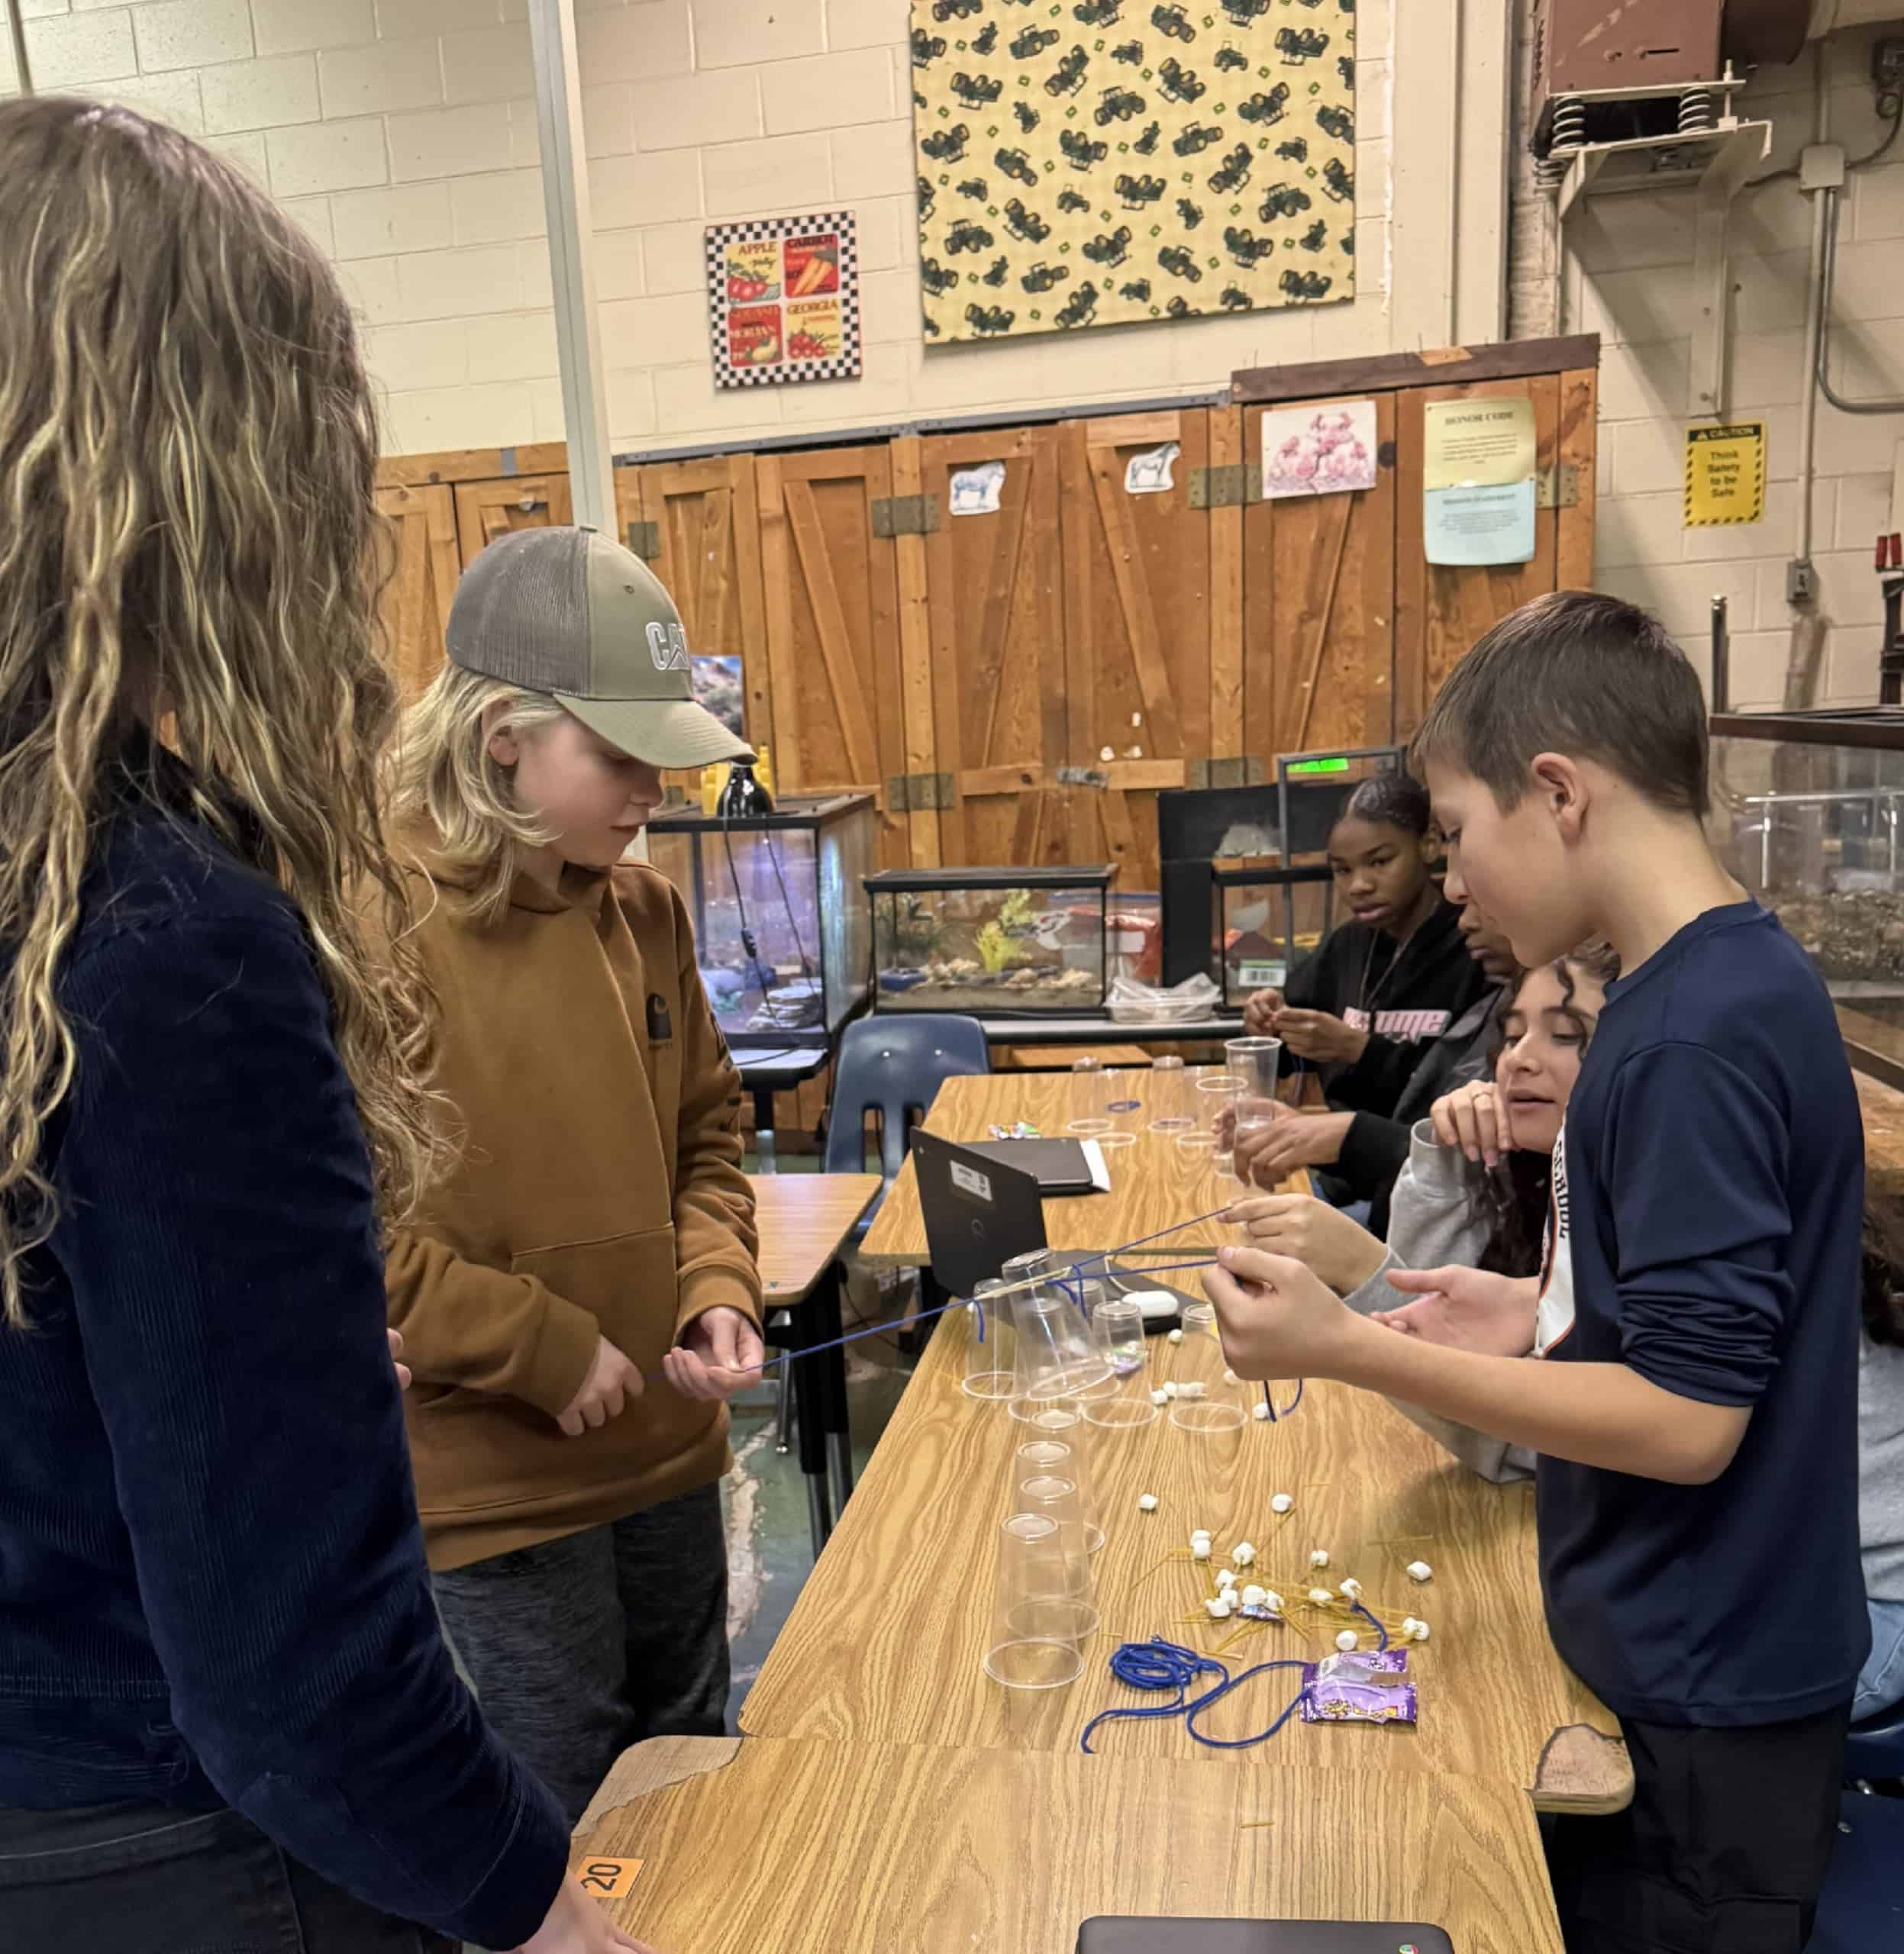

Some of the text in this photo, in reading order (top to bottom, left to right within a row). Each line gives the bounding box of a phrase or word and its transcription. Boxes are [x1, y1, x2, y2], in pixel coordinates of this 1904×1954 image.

[737, 241, 777, 256] APPLE
[787, 299, 839, 314] GEORGIA
[1711, 488, 1735, 498] Safe
[580, 1863, 622, 1891] 20
